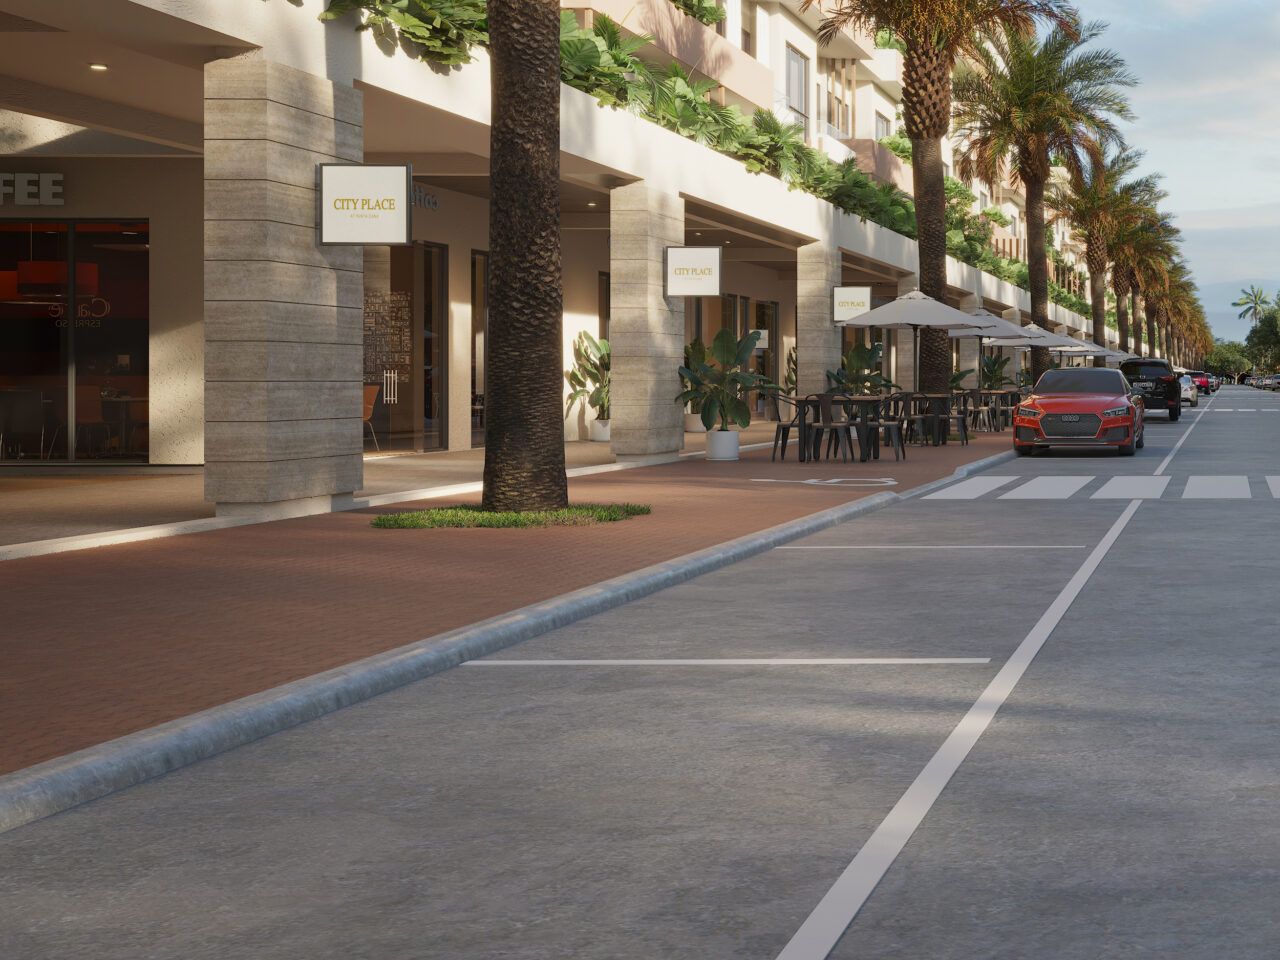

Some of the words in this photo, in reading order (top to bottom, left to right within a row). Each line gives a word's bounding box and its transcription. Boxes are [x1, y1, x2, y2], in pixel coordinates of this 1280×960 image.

[333, 198, 359, 210] CITY
[361, 198, 396, 210] PLACE
[674, 267, 690, 276] CITY
[691, 267, 713, 276] PLACE
